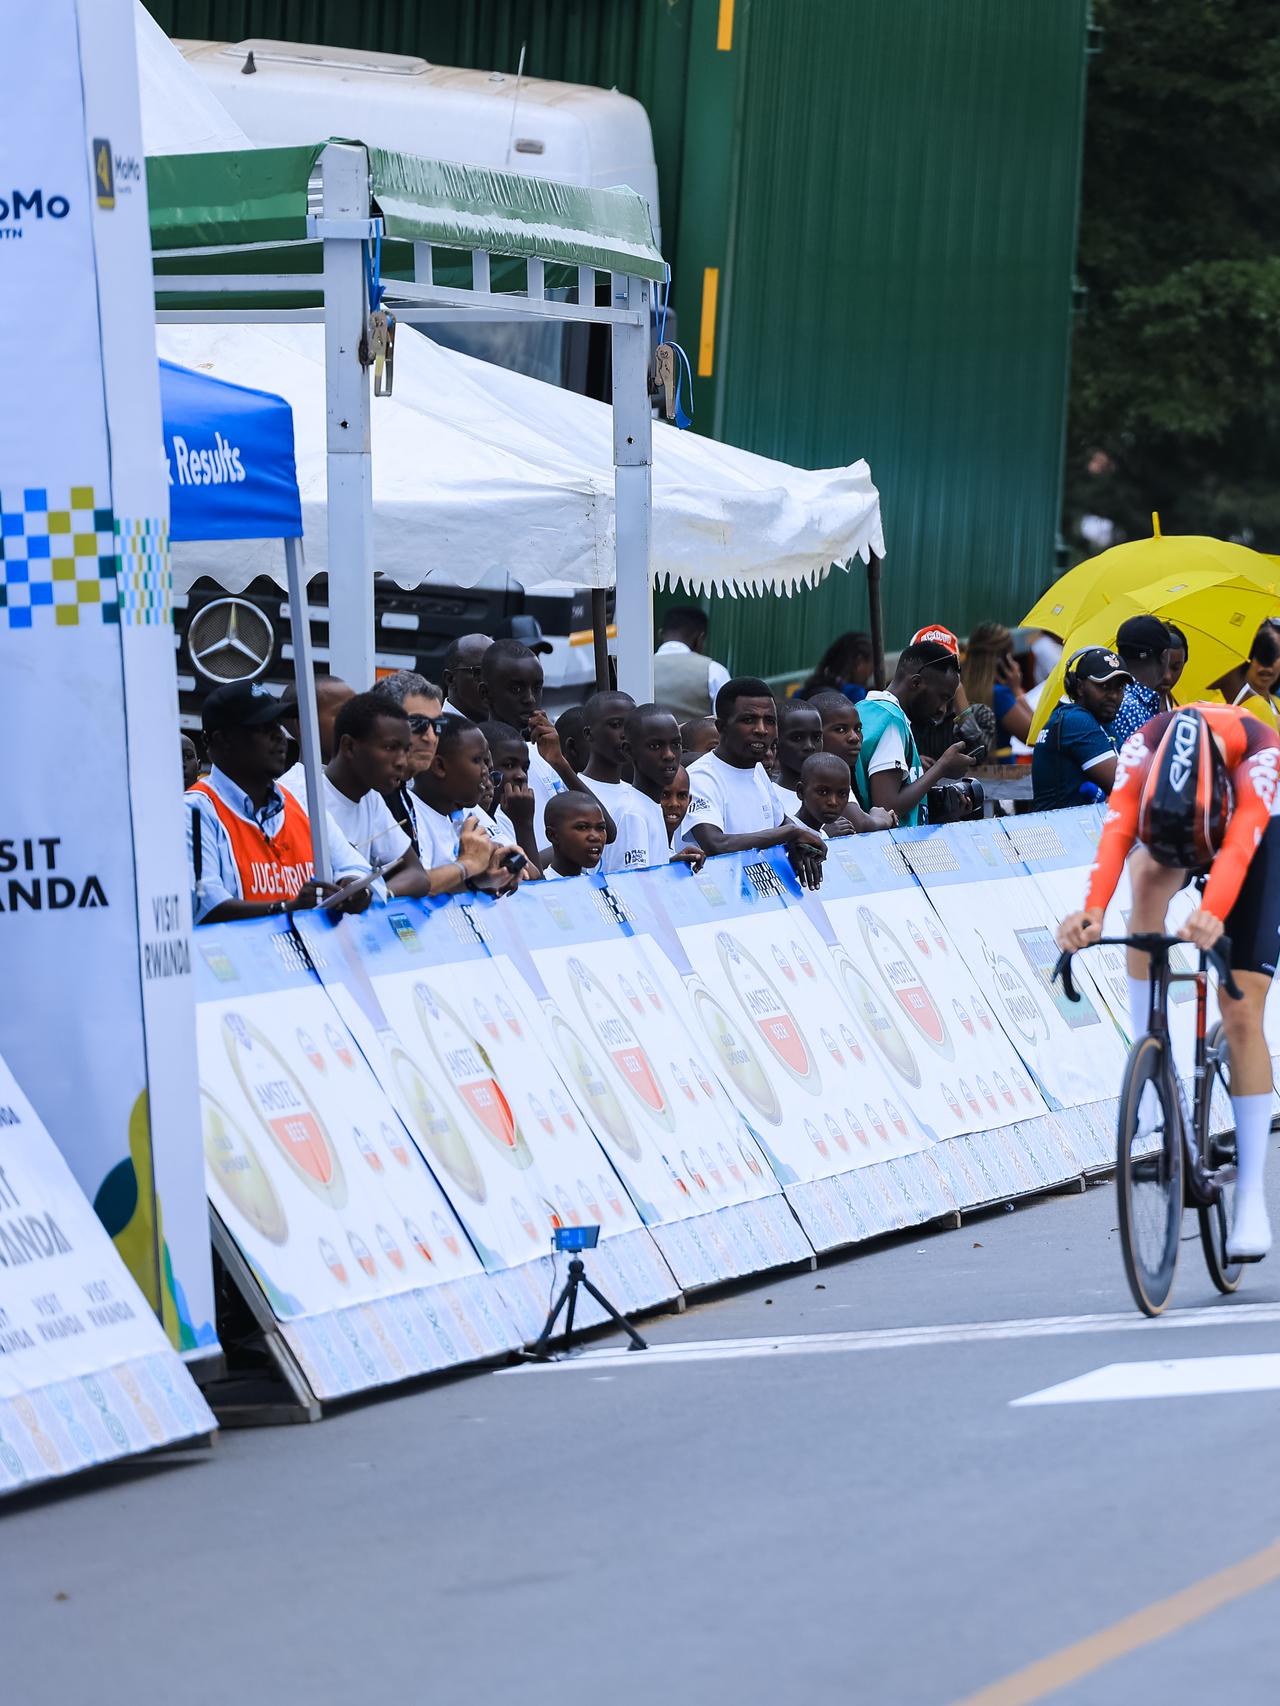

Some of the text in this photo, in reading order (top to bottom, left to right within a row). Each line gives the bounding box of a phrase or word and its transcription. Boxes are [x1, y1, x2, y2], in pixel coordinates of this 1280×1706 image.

[173, 431, 246, 486] Results
[251, 862, 283, 894] JUGE
[152, 894, 180, 933] VISIT
[144, 938, 191, 980] RWANDA
[745, 988, 781, 1015] AMSTEL
